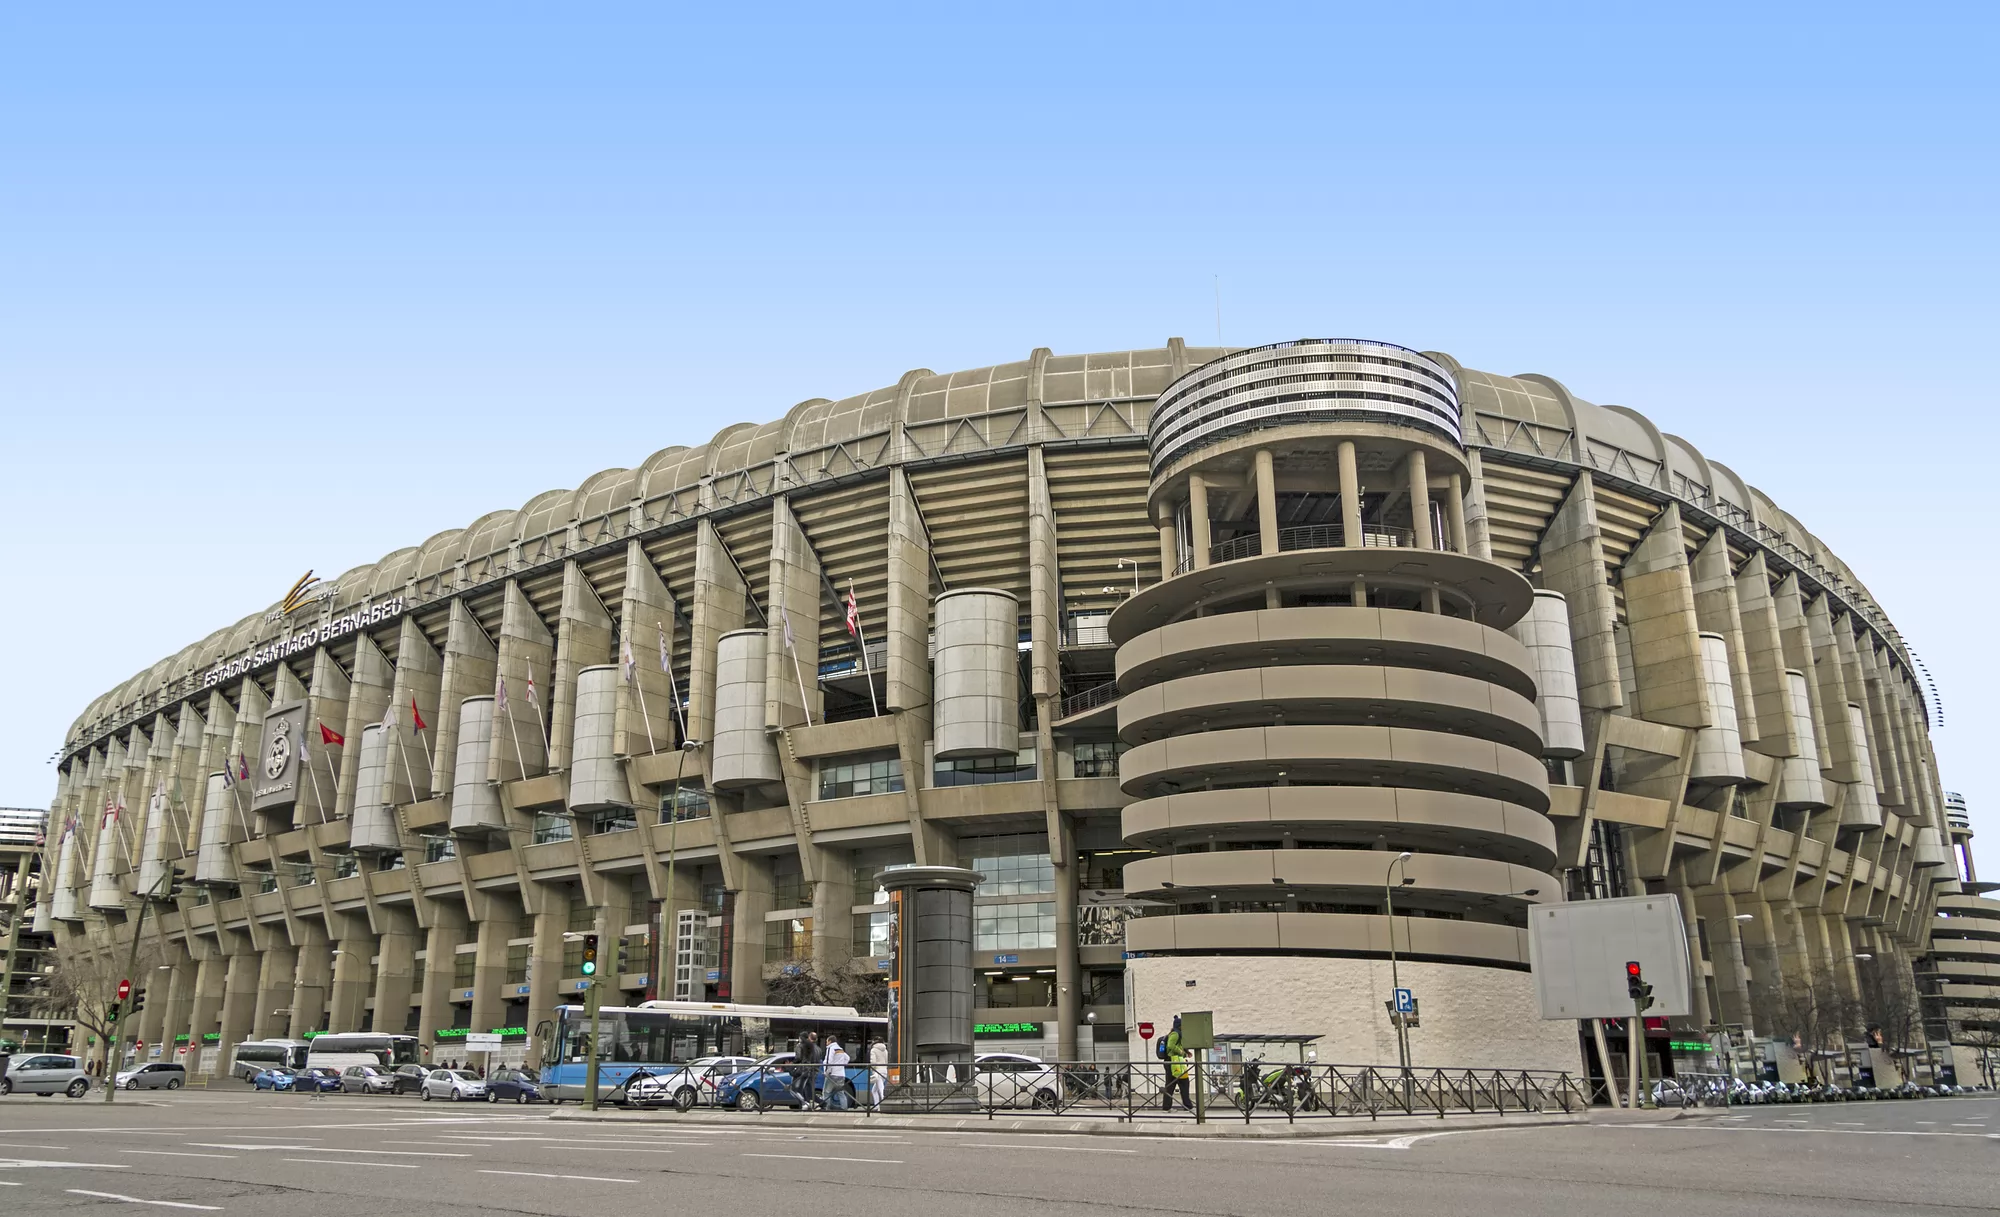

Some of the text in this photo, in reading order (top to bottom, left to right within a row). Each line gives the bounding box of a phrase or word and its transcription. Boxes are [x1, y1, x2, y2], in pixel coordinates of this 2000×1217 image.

[204, 595, 403, 688] ESTADIO SANTIAGO BERNABEU
[999, 955, 1007, 963] 14
[1398, 990, 1409, 1010] P
